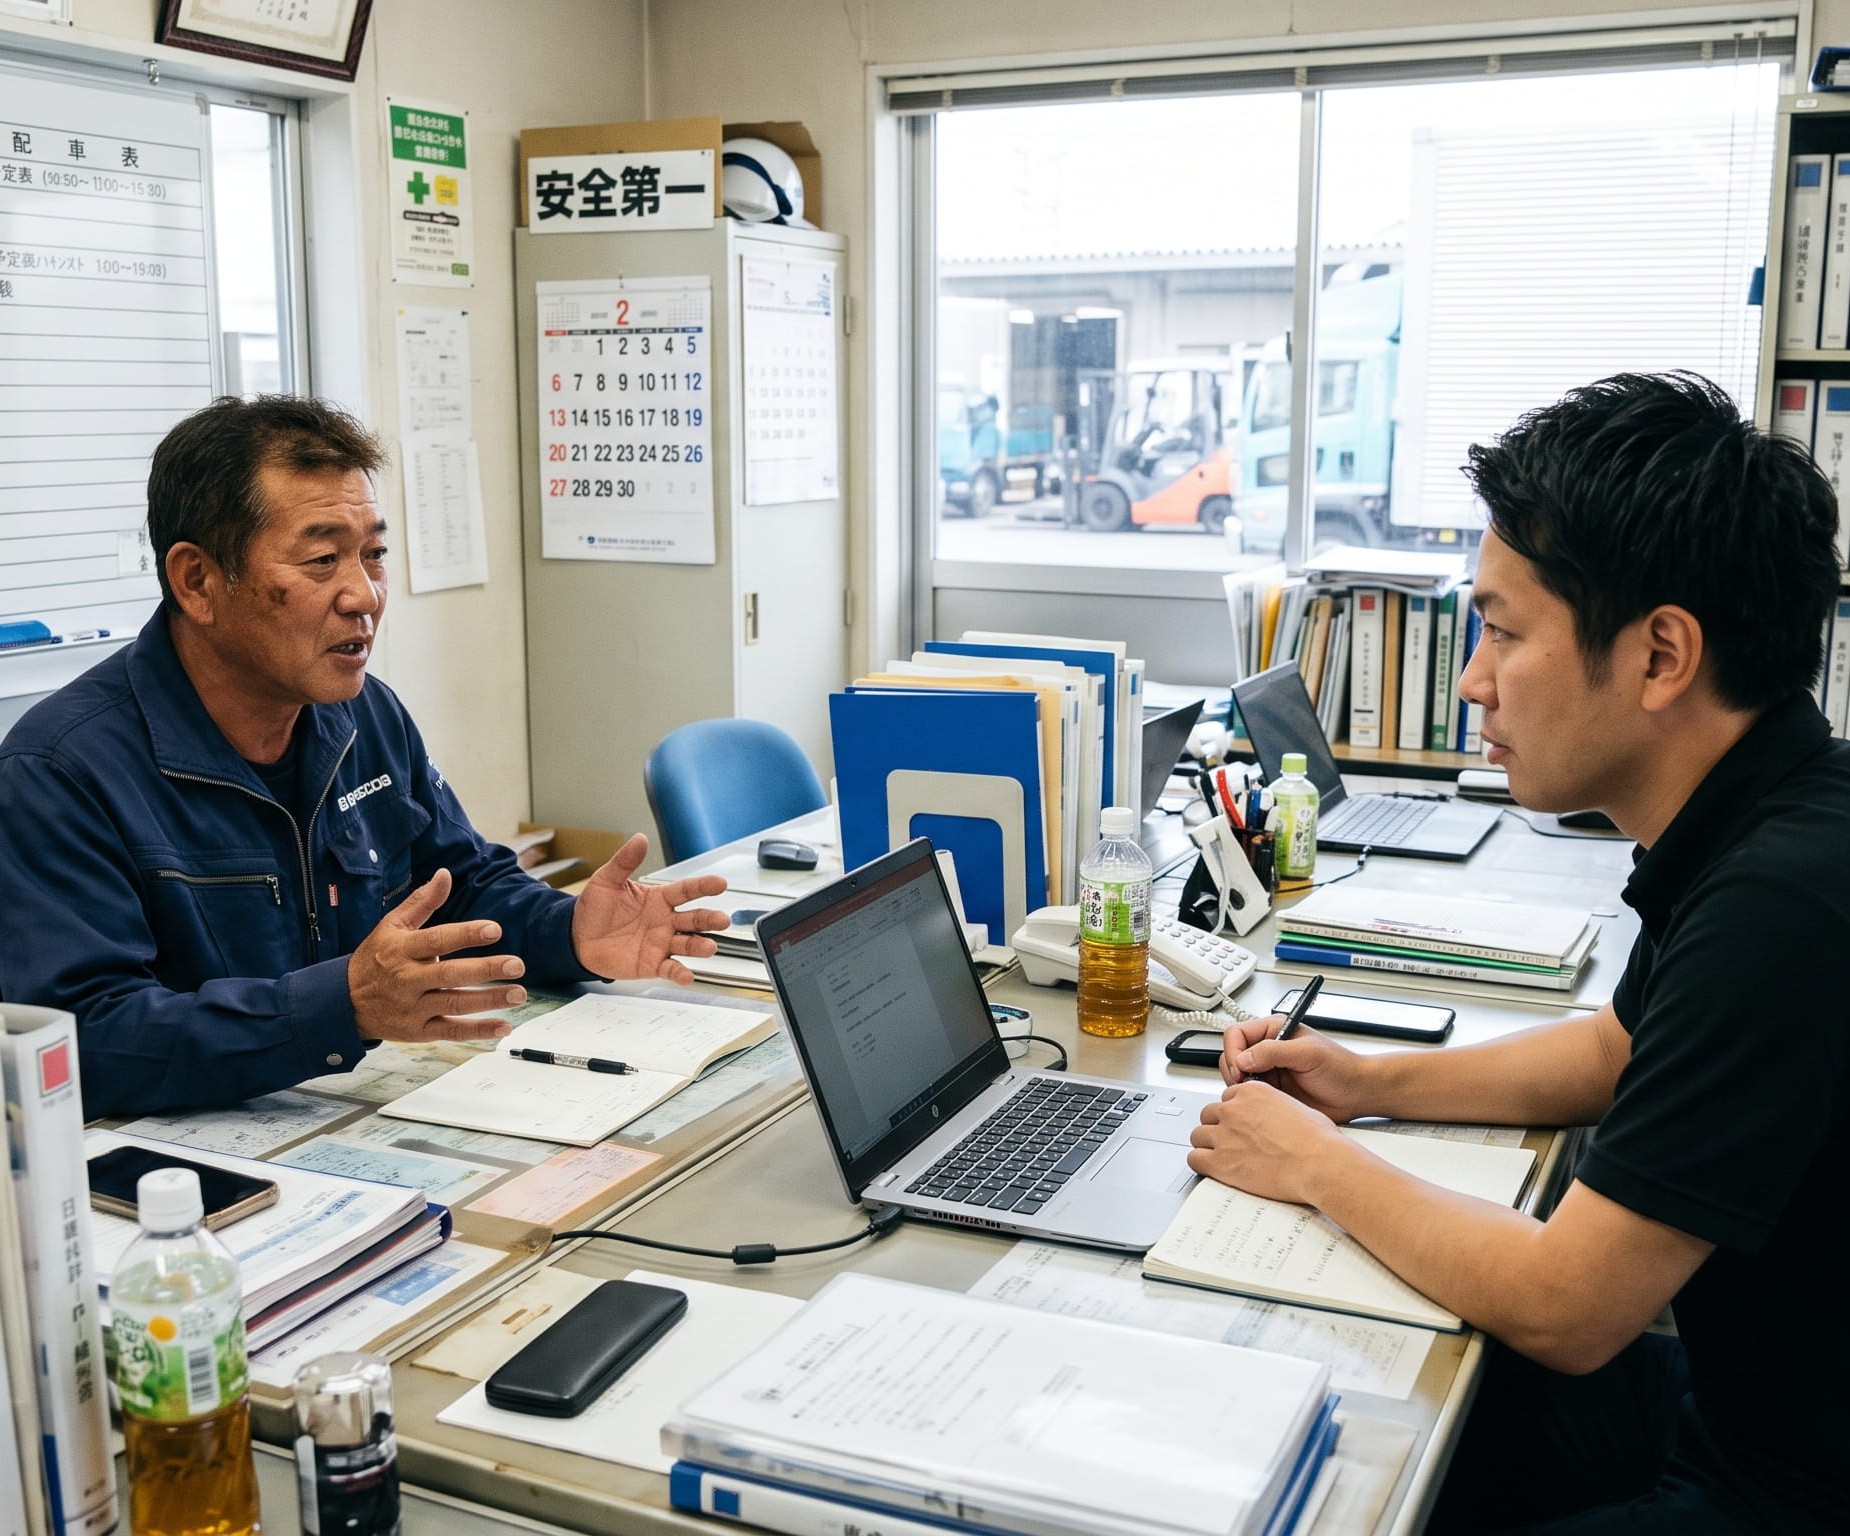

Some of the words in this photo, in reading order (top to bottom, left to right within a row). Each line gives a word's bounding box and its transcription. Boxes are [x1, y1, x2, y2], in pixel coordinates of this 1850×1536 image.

[0, 164, 33, 184] 定表
[536, 164, 705, 220] 安全第一
[616, 299, 630, 326] 2
[596, 338, 603, 356] 1
[618, 336, 628, 356] 2
[641, 336, 651, 356] 3
[664, 336, 674, 355] 4
[687, 335, 697, 355] 5
[551, 373, 562, 393] 6
[573, 373, 583, 391] 7
[596, 373, 606, 392] 8
[618, 373, 628, 392] 9
[638, 372, 656, 392] 10
[661, 373, 677, 391] 11
[684, 372, 702, 391] 12
[549, 408, 567, 427] 13
[571, 408, 589, 426] 14
[593, 408, 612, 427] 15
[616, 408, 634, 427] 16
[638, 408, 656, 426] 17
[661, 408, 680, 427] 18
[684, 408, 703, 427] 19
[548, 443, 567, 462] 20
[571, 443, 588, 462] 21
[593, 443, 612, 462] 22
[616, 444, 635, 463] 23
[638, 444, 657, 463] 24
[661, 444, 680, 463] 25
[684, 444, 703, 464] 26
[549, 478, 568, 497] 27
[572, 478, 591, 497] 28
[594, 479, 613, 498] 29
[616, 479, 635, 498] 30
